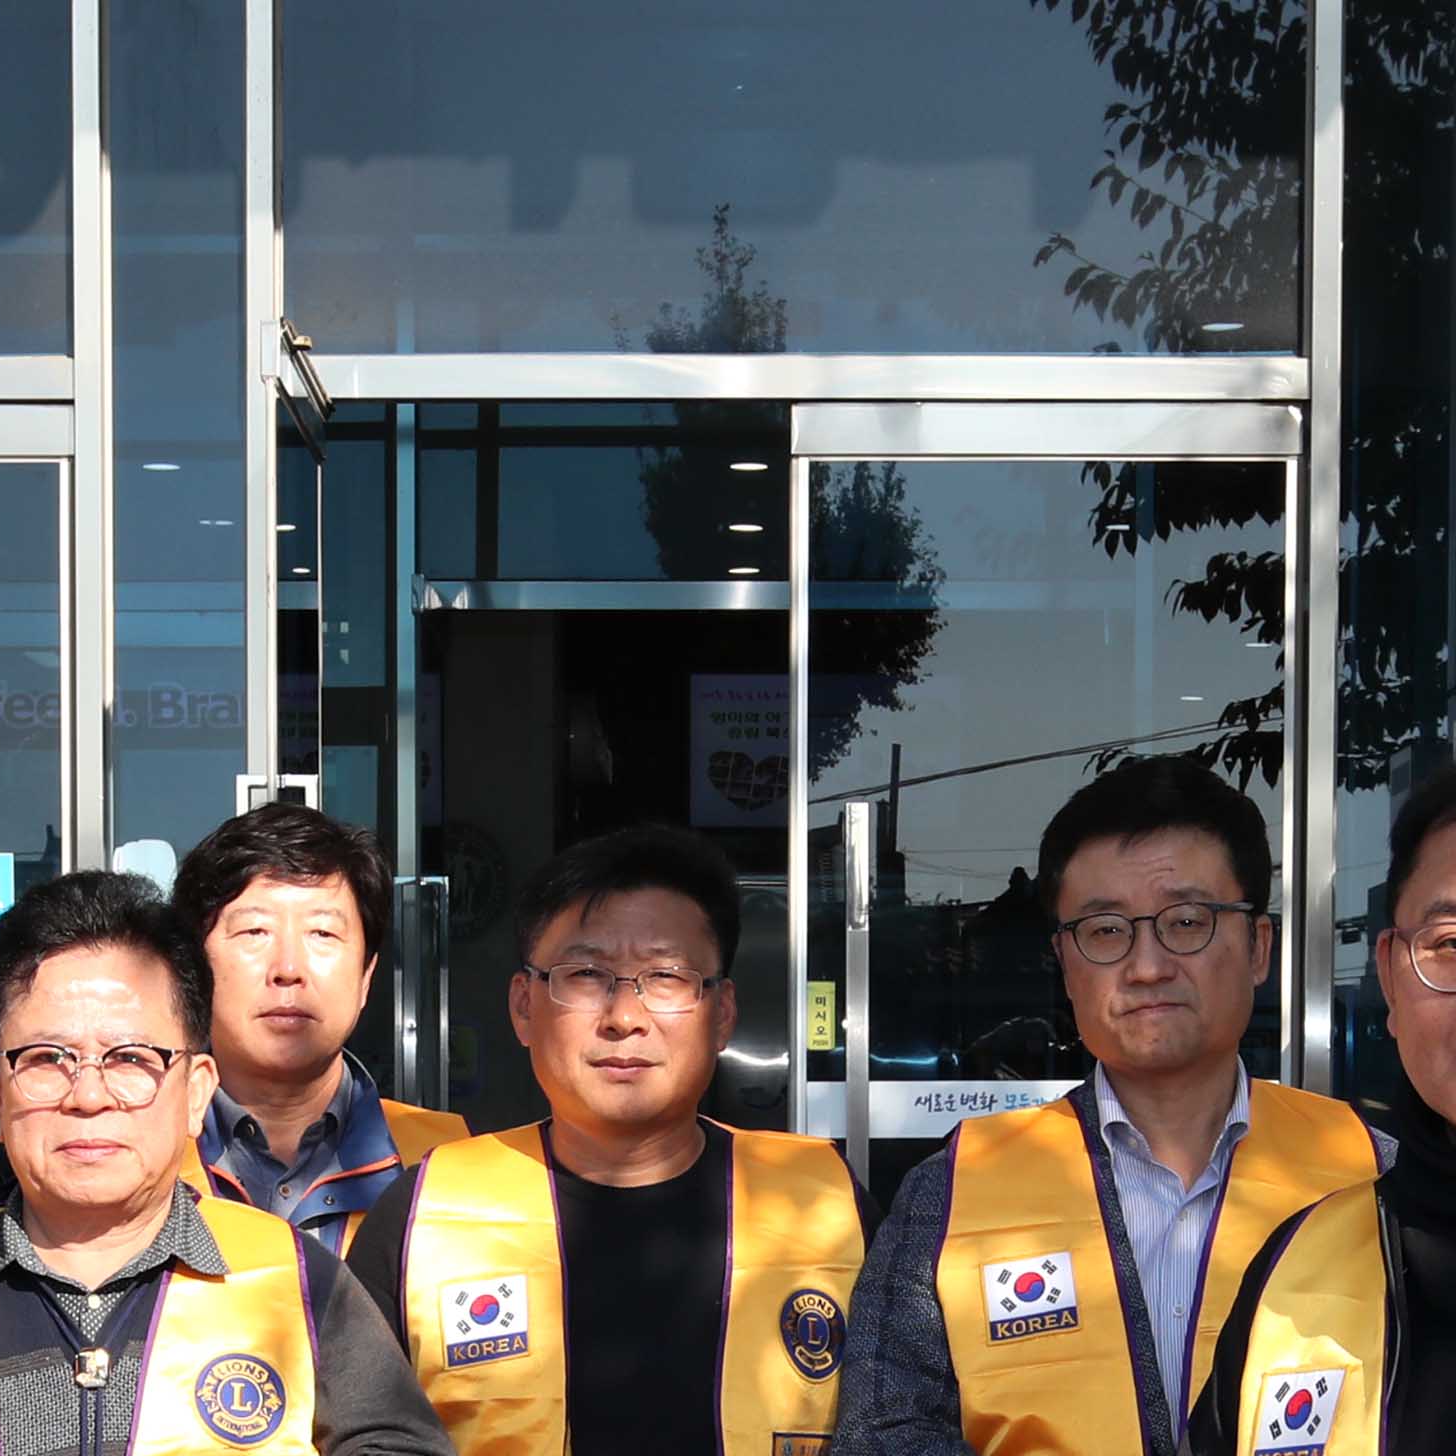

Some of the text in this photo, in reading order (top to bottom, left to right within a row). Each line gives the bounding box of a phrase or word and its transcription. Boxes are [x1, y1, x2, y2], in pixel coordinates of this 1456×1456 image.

[796, 1296, 833, 1316] LIONS
[807, 1317, 821, 1344] L
[996, 1311, 1076, 1338] KOREA
[454, 1336, 524, 1360] KOREA
[217, 1362, 265, 1380] LIONS
[230, 1382, 252, 1411] L
